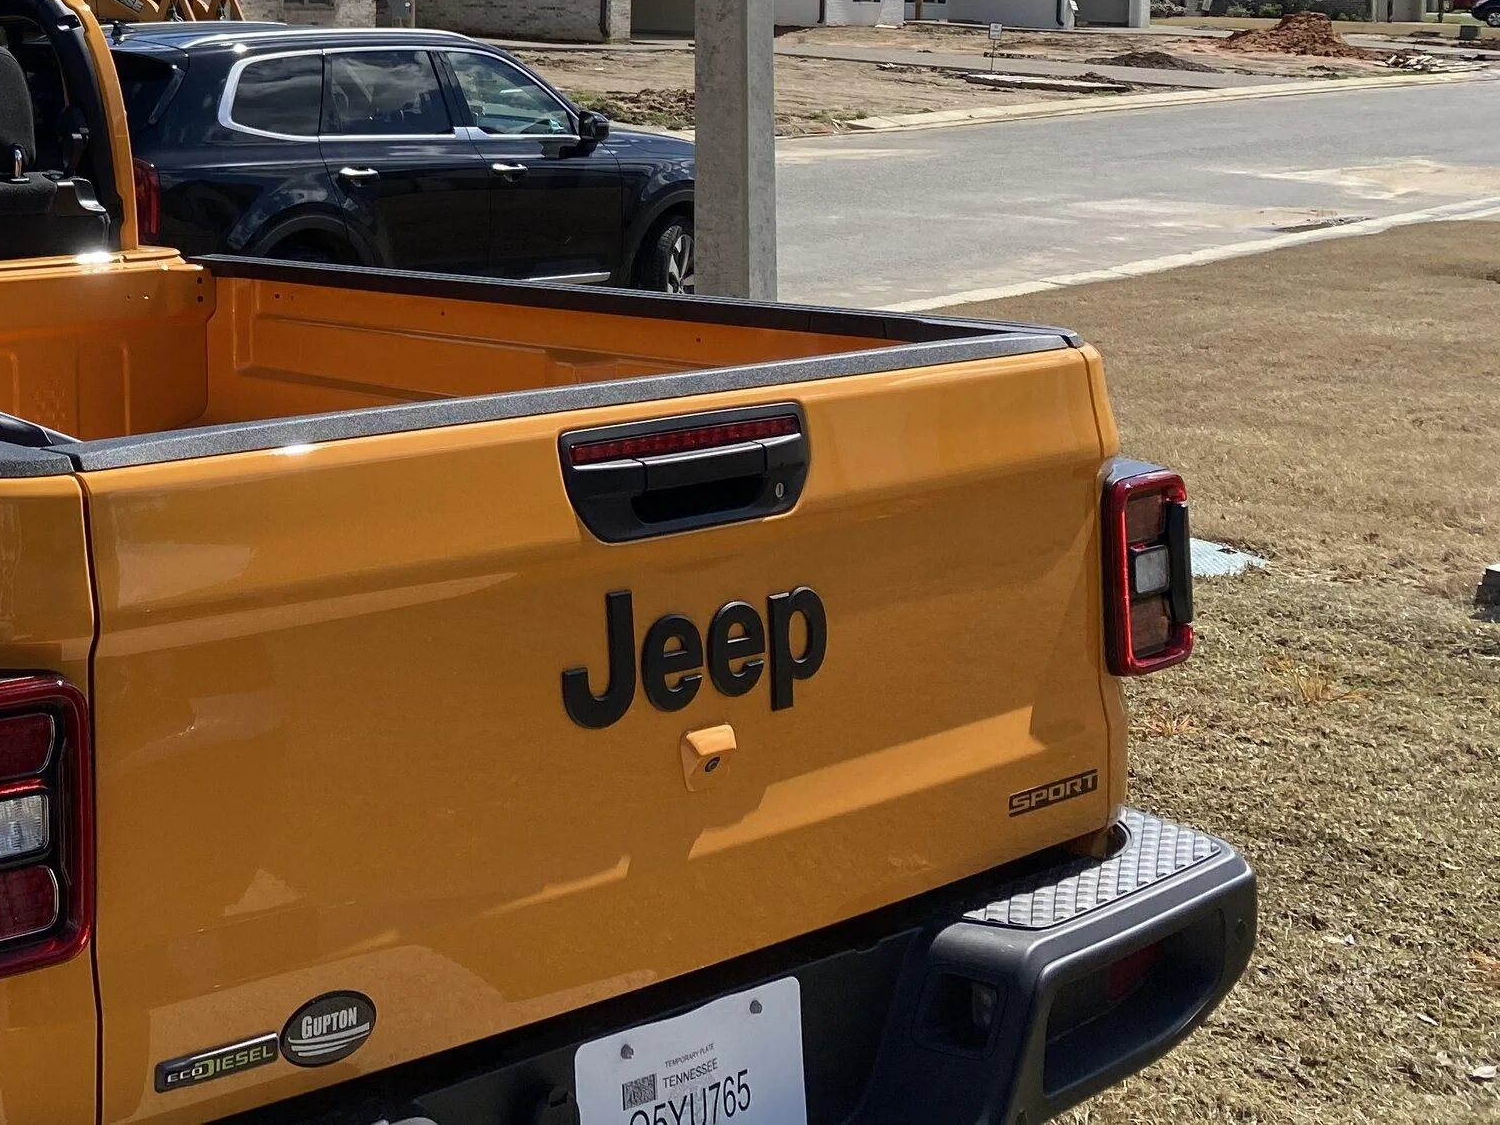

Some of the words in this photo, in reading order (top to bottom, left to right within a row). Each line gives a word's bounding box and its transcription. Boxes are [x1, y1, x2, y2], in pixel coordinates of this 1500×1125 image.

[562, 585, 827, 729] Jeep
[1008, 773, 1098, 815] SPORT
[301, 1006, 358, 1039] GUPTON
[662, 1057, 718, 1088] TENNESSEE
[664, 1051, 700, 1069] TEMPORARY
[700, 1043, 715, 1056] PLATE
